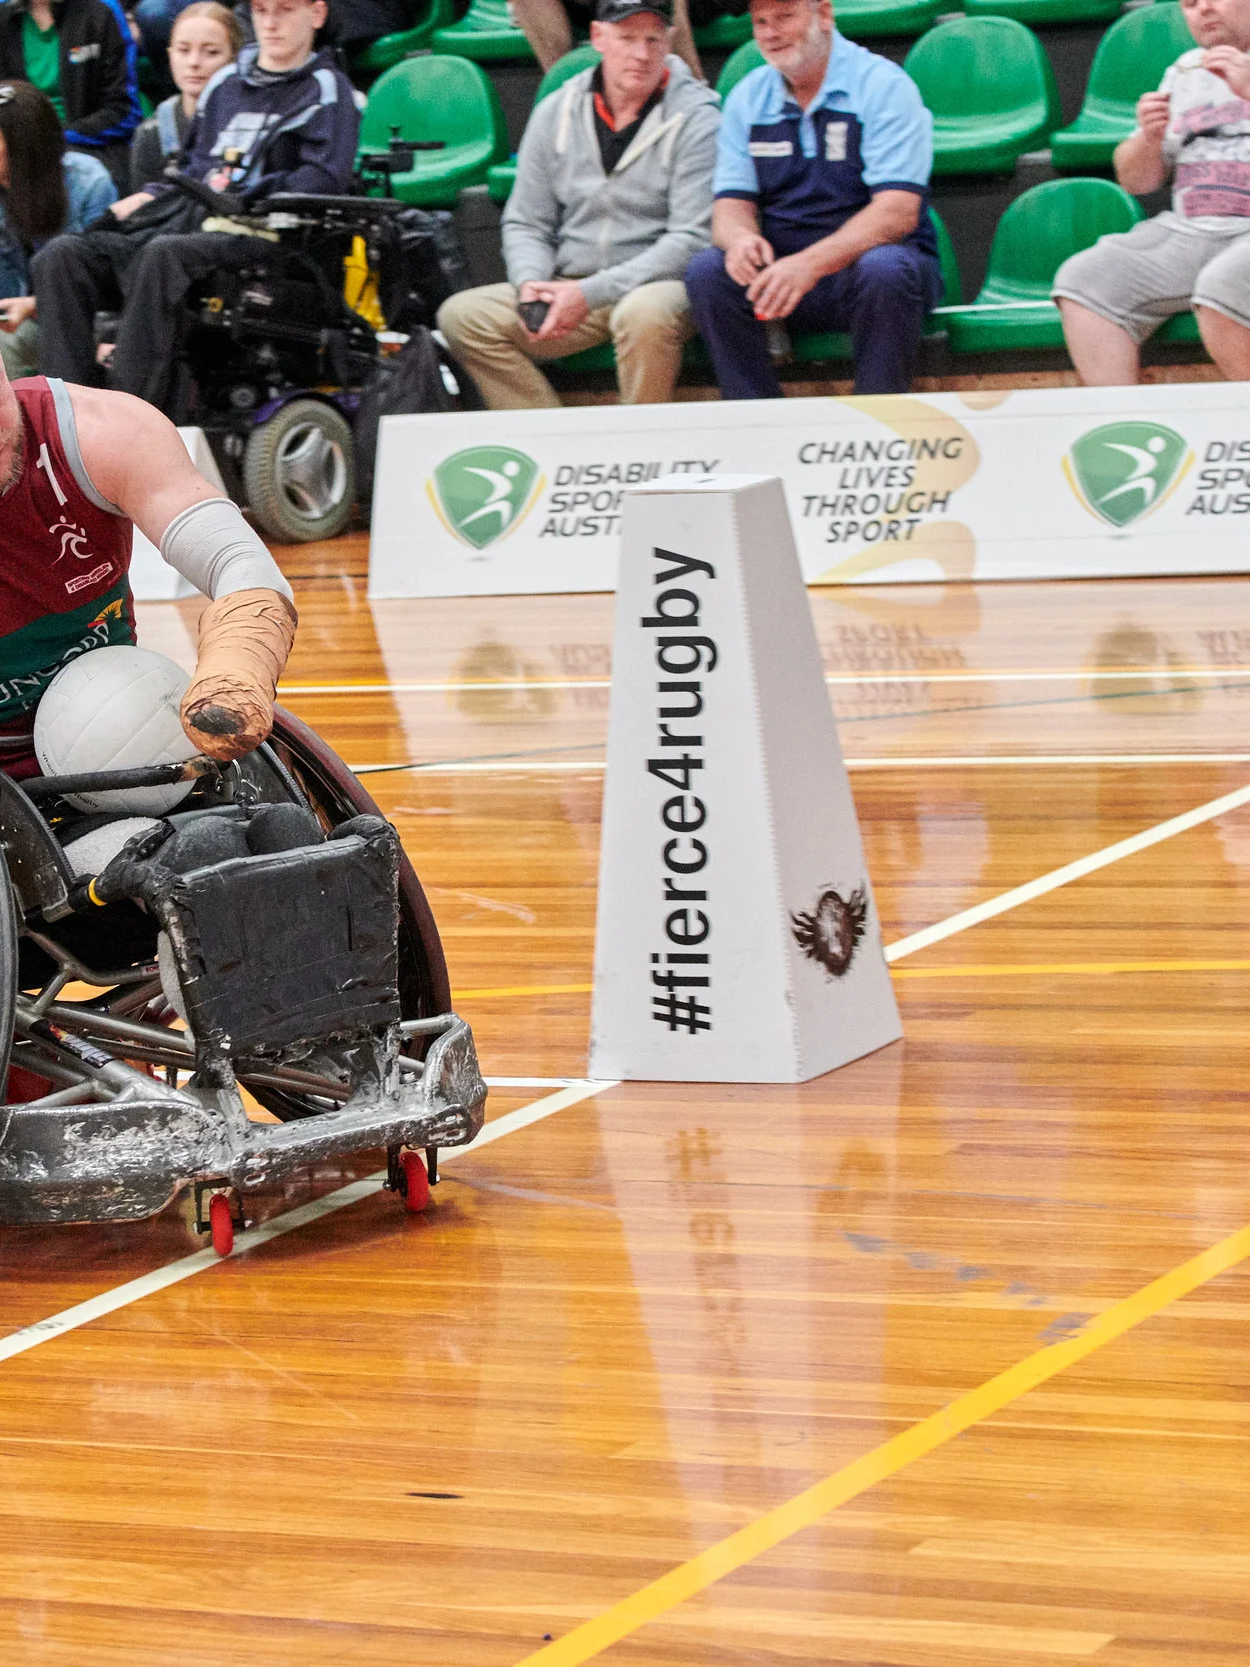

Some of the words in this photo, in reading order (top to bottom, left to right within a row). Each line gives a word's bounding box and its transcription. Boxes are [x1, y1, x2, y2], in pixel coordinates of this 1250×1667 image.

[799, 437, 964, 464] CHANGING
[36, 443, 68, 506] 1
[839, 466, 916, 489] LIVES
[802, 492, 952, 517] THROUGH
[539, 516, 622, 538] AUST
[826, 518, 922, 543] SPORT
[640, 546, 718, 1035] #fierce4rugby
